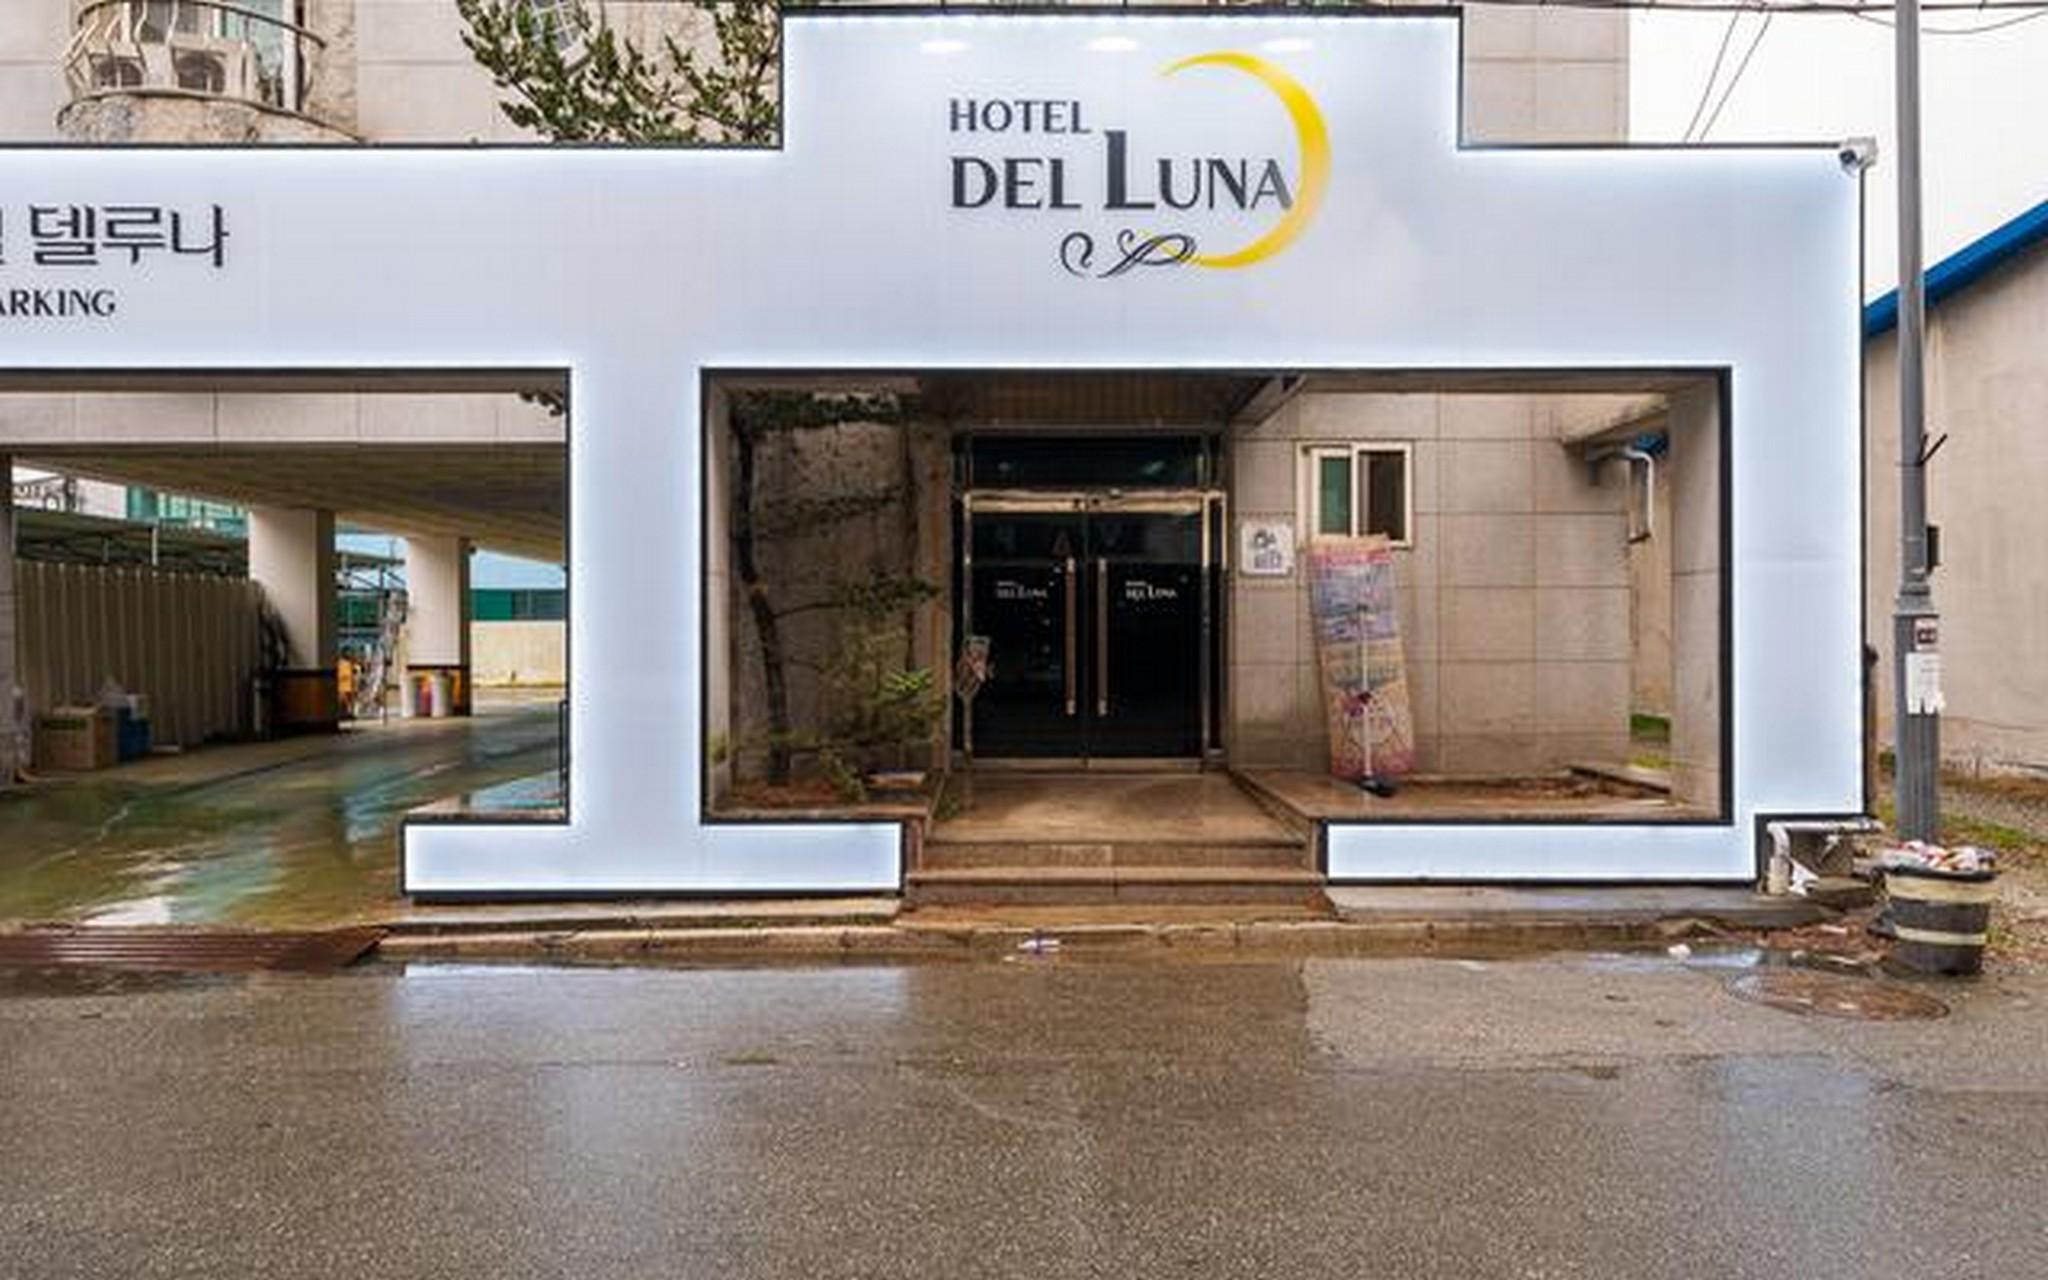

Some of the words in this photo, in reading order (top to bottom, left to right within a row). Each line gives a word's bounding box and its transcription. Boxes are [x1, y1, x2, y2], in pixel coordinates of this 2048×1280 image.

[949, 99, 1091, 134] HOTEL
[951, 156, 1083, 210] DEL
[1103, 130, 1293, 211] LUNA
[28, 204, 231, 269] 델루나
